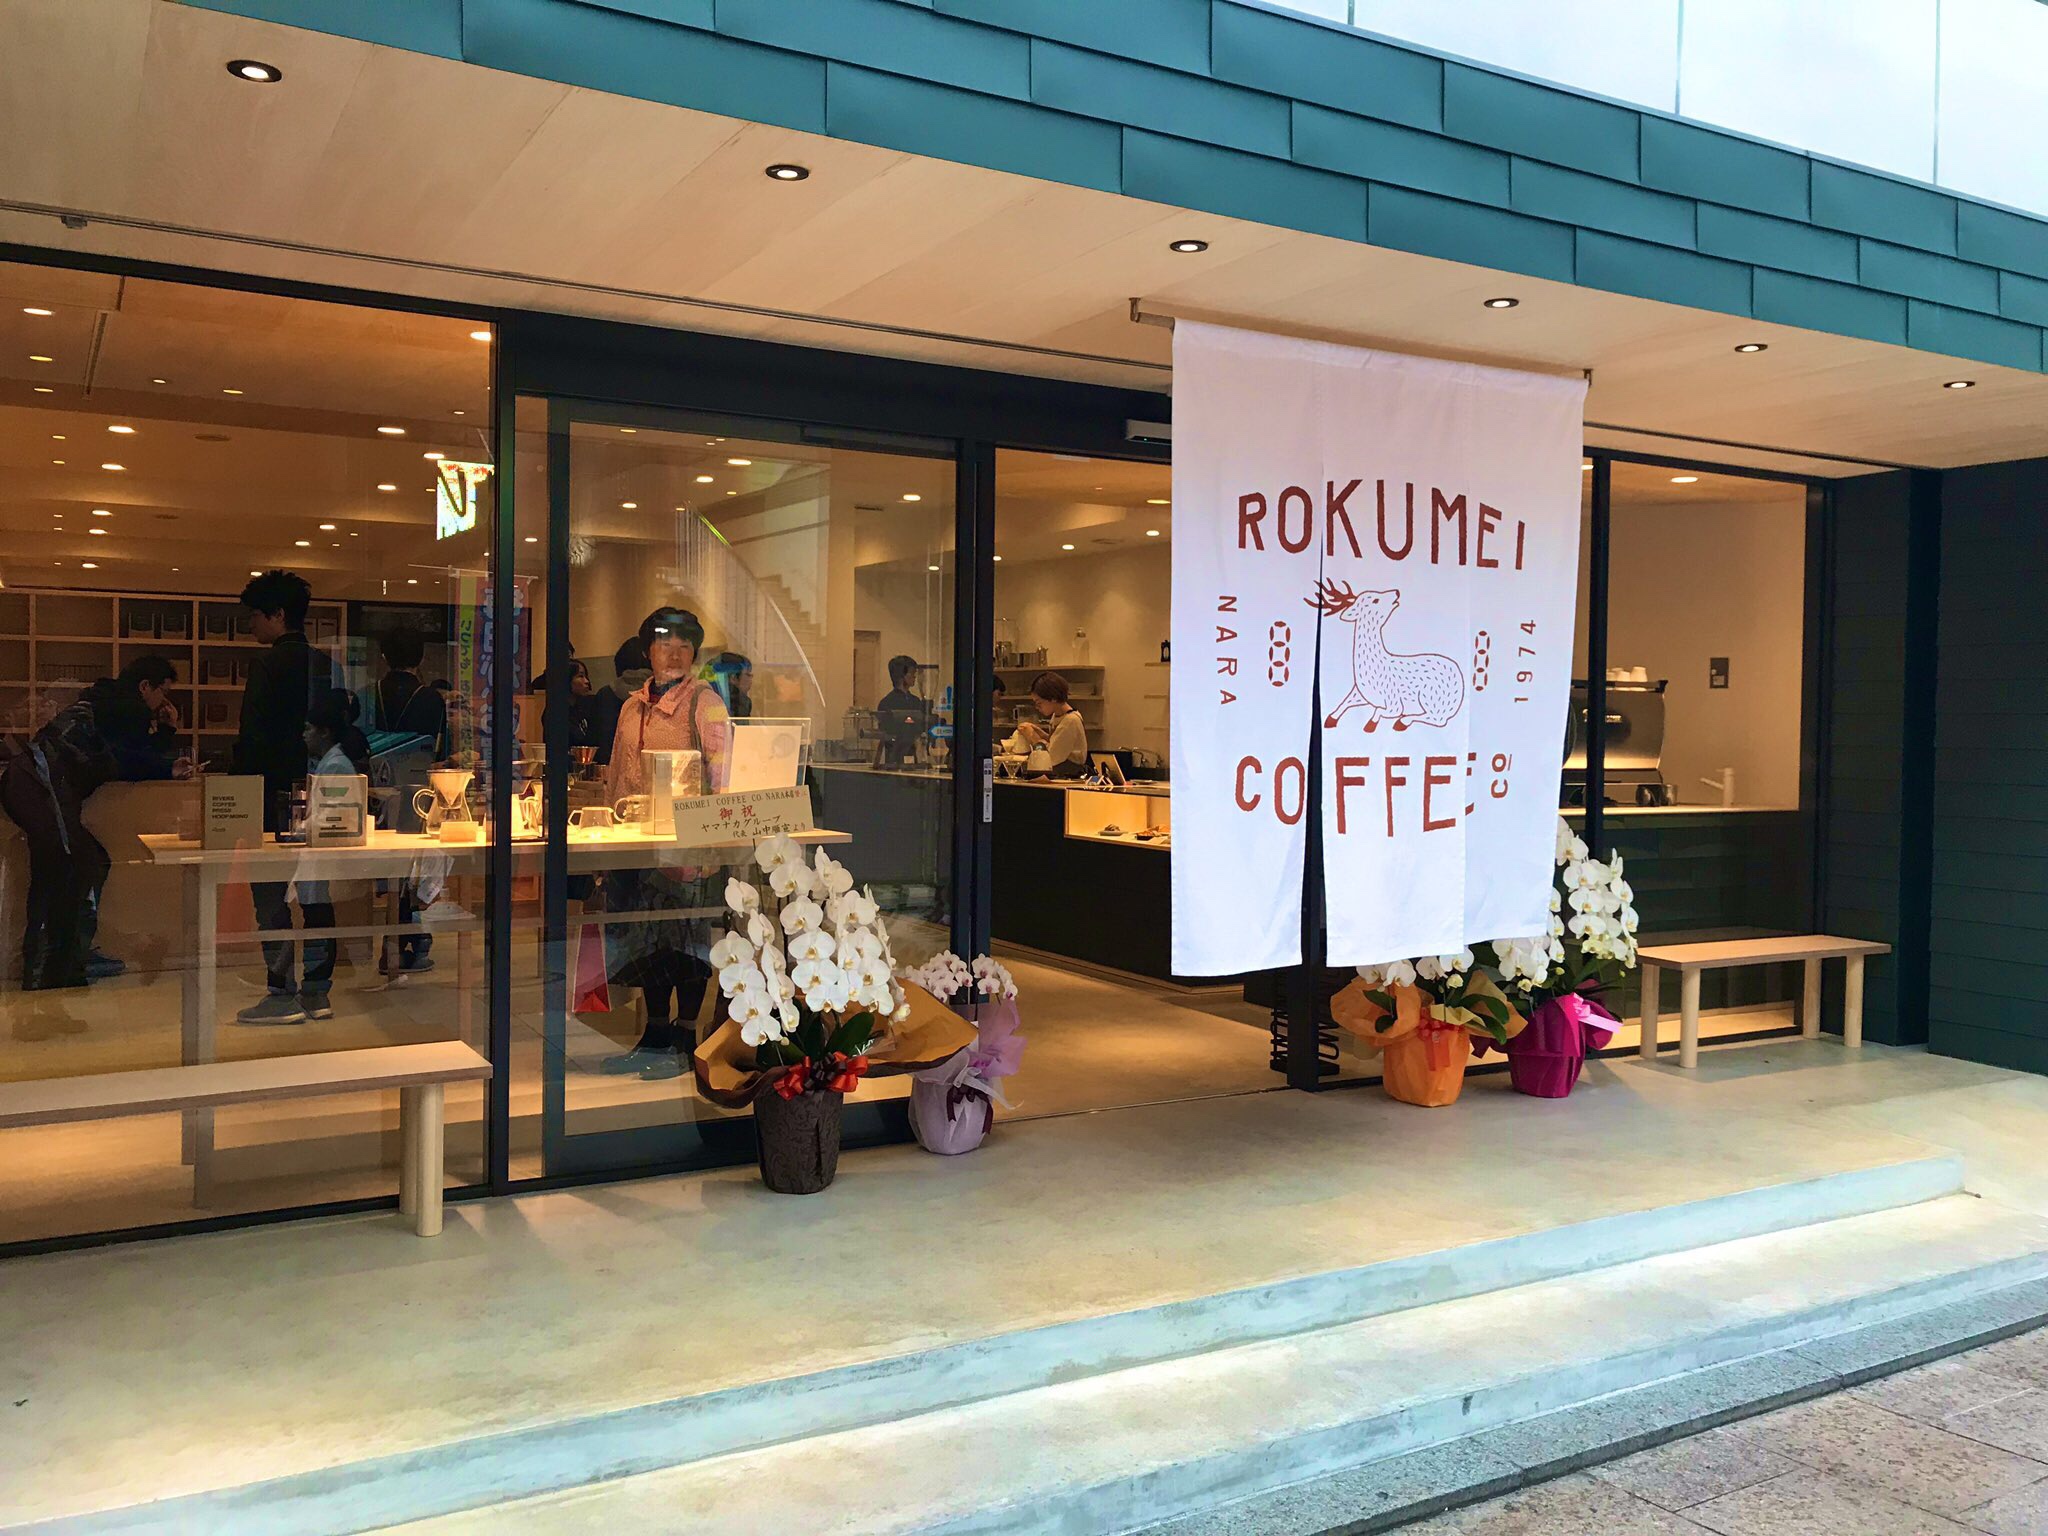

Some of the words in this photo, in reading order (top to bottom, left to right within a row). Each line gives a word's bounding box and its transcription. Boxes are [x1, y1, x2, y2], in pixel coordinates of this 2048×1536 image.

[1238, 479, 1525, 570] ROKUMEI
[1216, 595, 1237, 705] NARA
[1514, 619, 1537, 703] 1974
[674, 799, 711, 811] ROKUMEI
[716, 794, 747, 806] COFFEE
